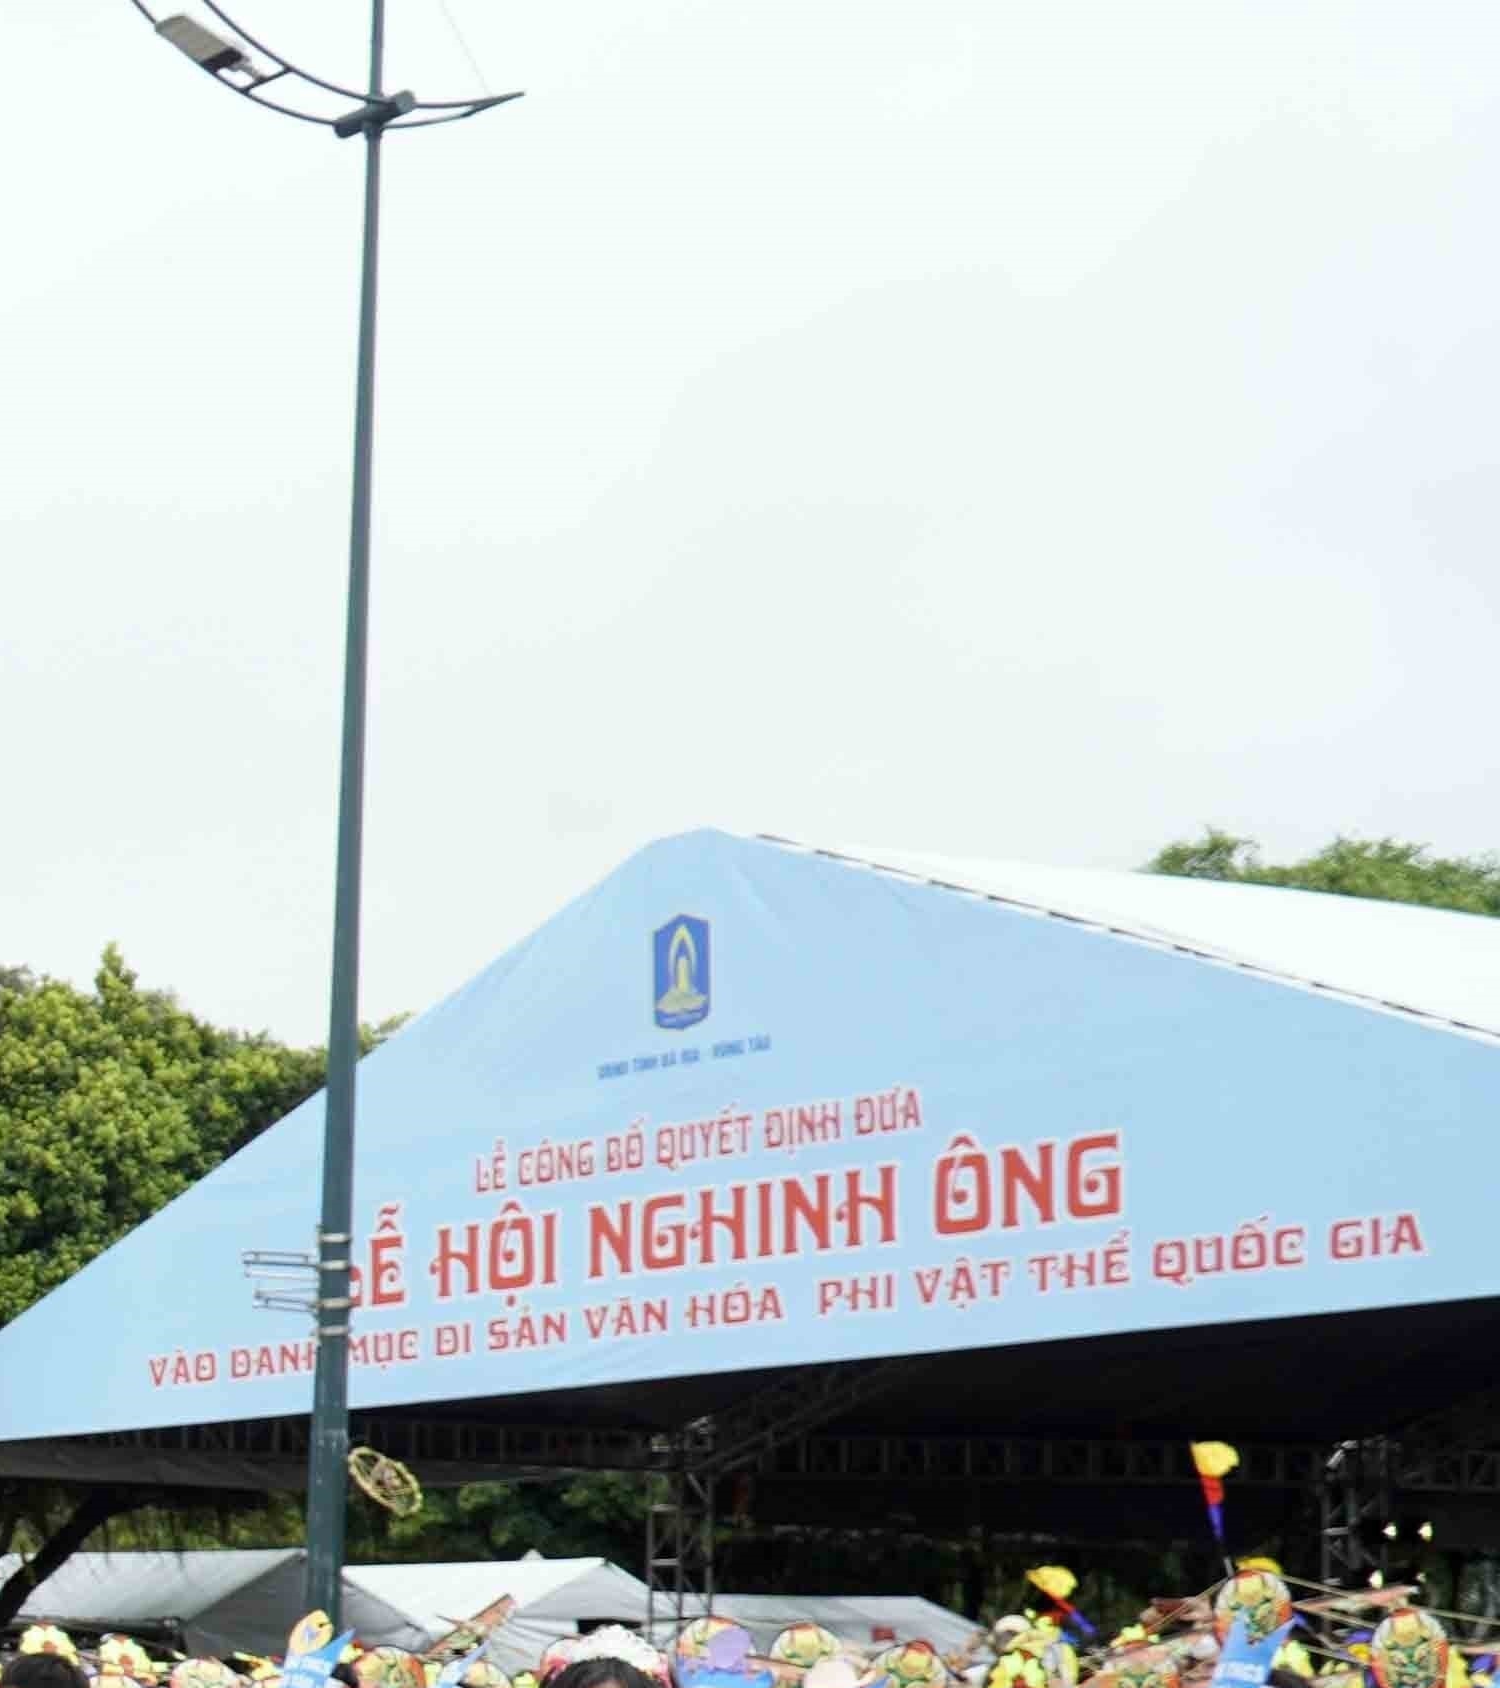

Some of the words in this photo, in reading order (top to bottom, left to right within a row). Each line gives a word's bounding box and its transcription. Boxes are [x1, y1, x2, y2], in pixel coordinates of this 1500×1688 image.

[606, 1116, 646, 1173] BỐ
[656, 1102, 753, 1169] QUYẾT
[764, 1101, 841, 1154] ĐỊNH
[854, 1087, 921, 1135] ĐƯA
[149, 1349, 216, 1387] VÀO
[488, 1305, 567, 1350] SẢN
[583, 1296, 668, 1339] VĂN
[686, 1282, 783, 1328] HÓA
[819, 1274, 894, 1314] PHI
[915, 1257, 1010, 1309] VẬT
[1028, 1230, 1131, 1293] THỂ
[1153, 1216, 1306, 1286] QUỐC
[1329, 1214, 1423, 1260] GIA
[430, 1201, 556, 1308] HỘI
[589, 1165, 896, 1279] NGHINH
[935, 1134, 1122, 1235] ÔNG
